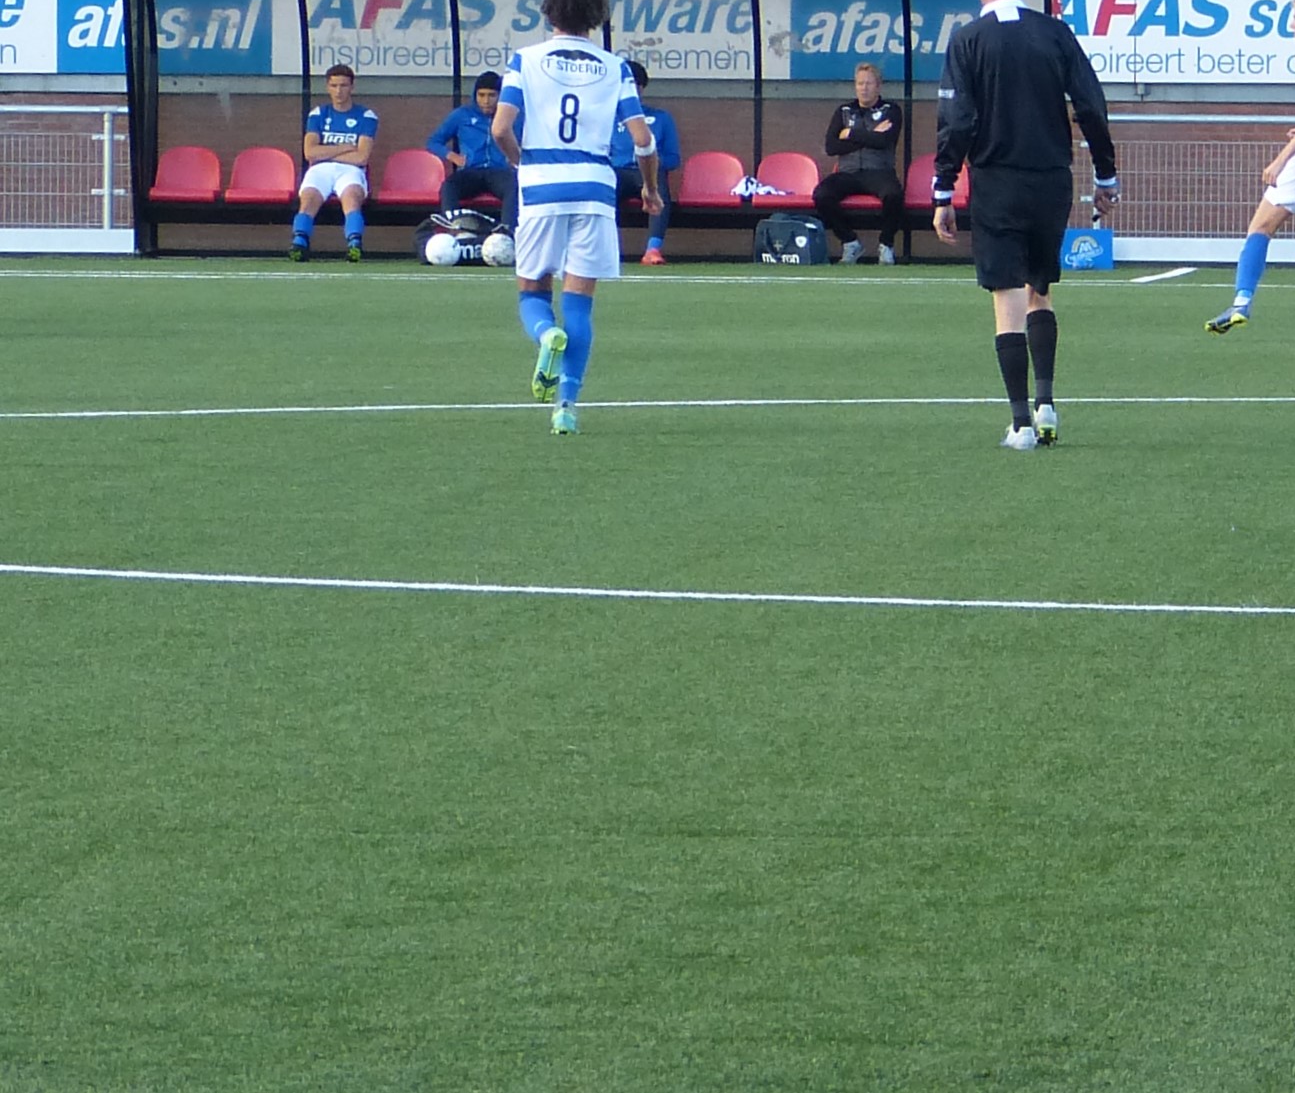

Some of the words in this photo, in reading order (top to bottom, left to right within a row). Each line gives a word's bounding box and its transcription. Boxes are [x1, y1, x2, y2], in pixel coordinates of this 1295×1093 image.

[801, 1, 975, 55] afas.n
[311, 38, 452, 72] inspireert
[1197, 45, 1277, 75] beter
[558, 93, 580, 144] 8
